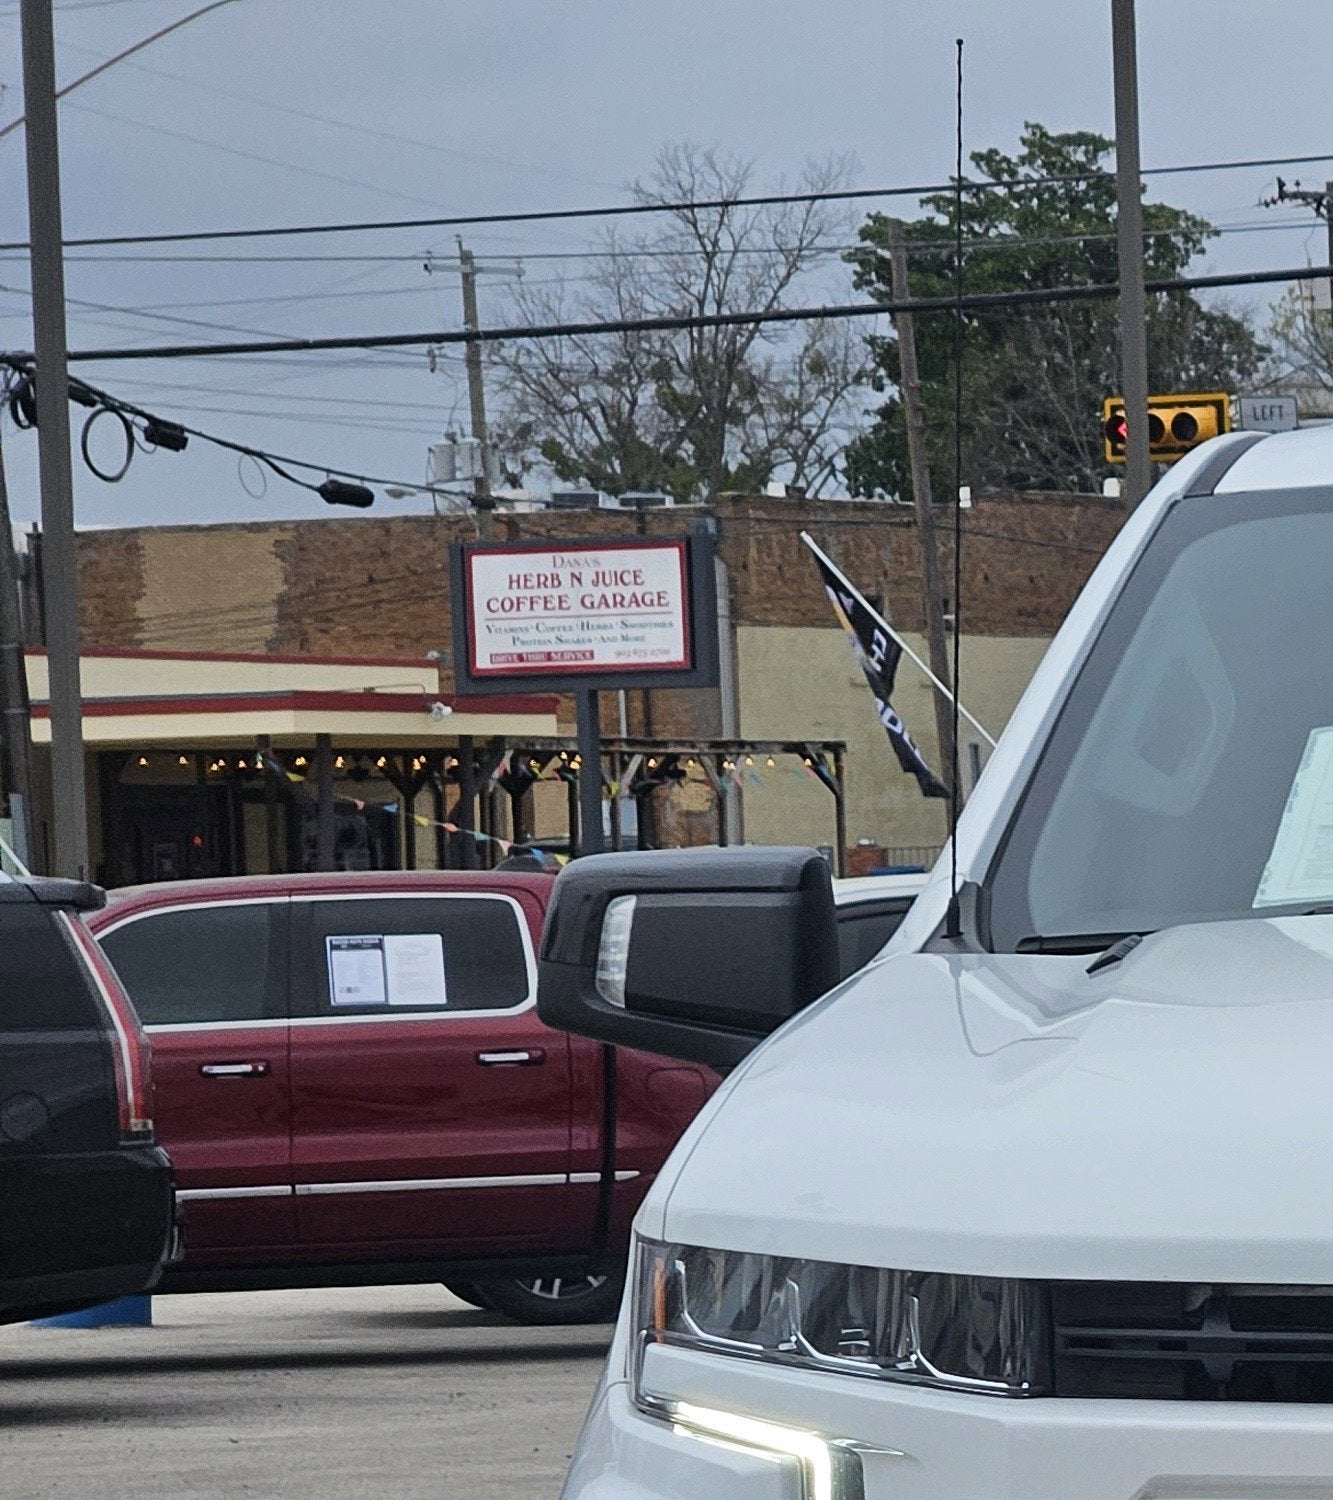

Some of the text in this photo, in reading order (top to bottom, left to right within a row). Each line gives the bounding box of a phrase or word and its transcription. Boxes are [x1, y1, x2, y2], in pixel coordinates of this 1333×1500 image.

[1253, 404, 1283, 422] LEFT
[508, 569, 645, 591] HERB N JUICE
[486, 590, 670, 614] COFFEE GARAGE
